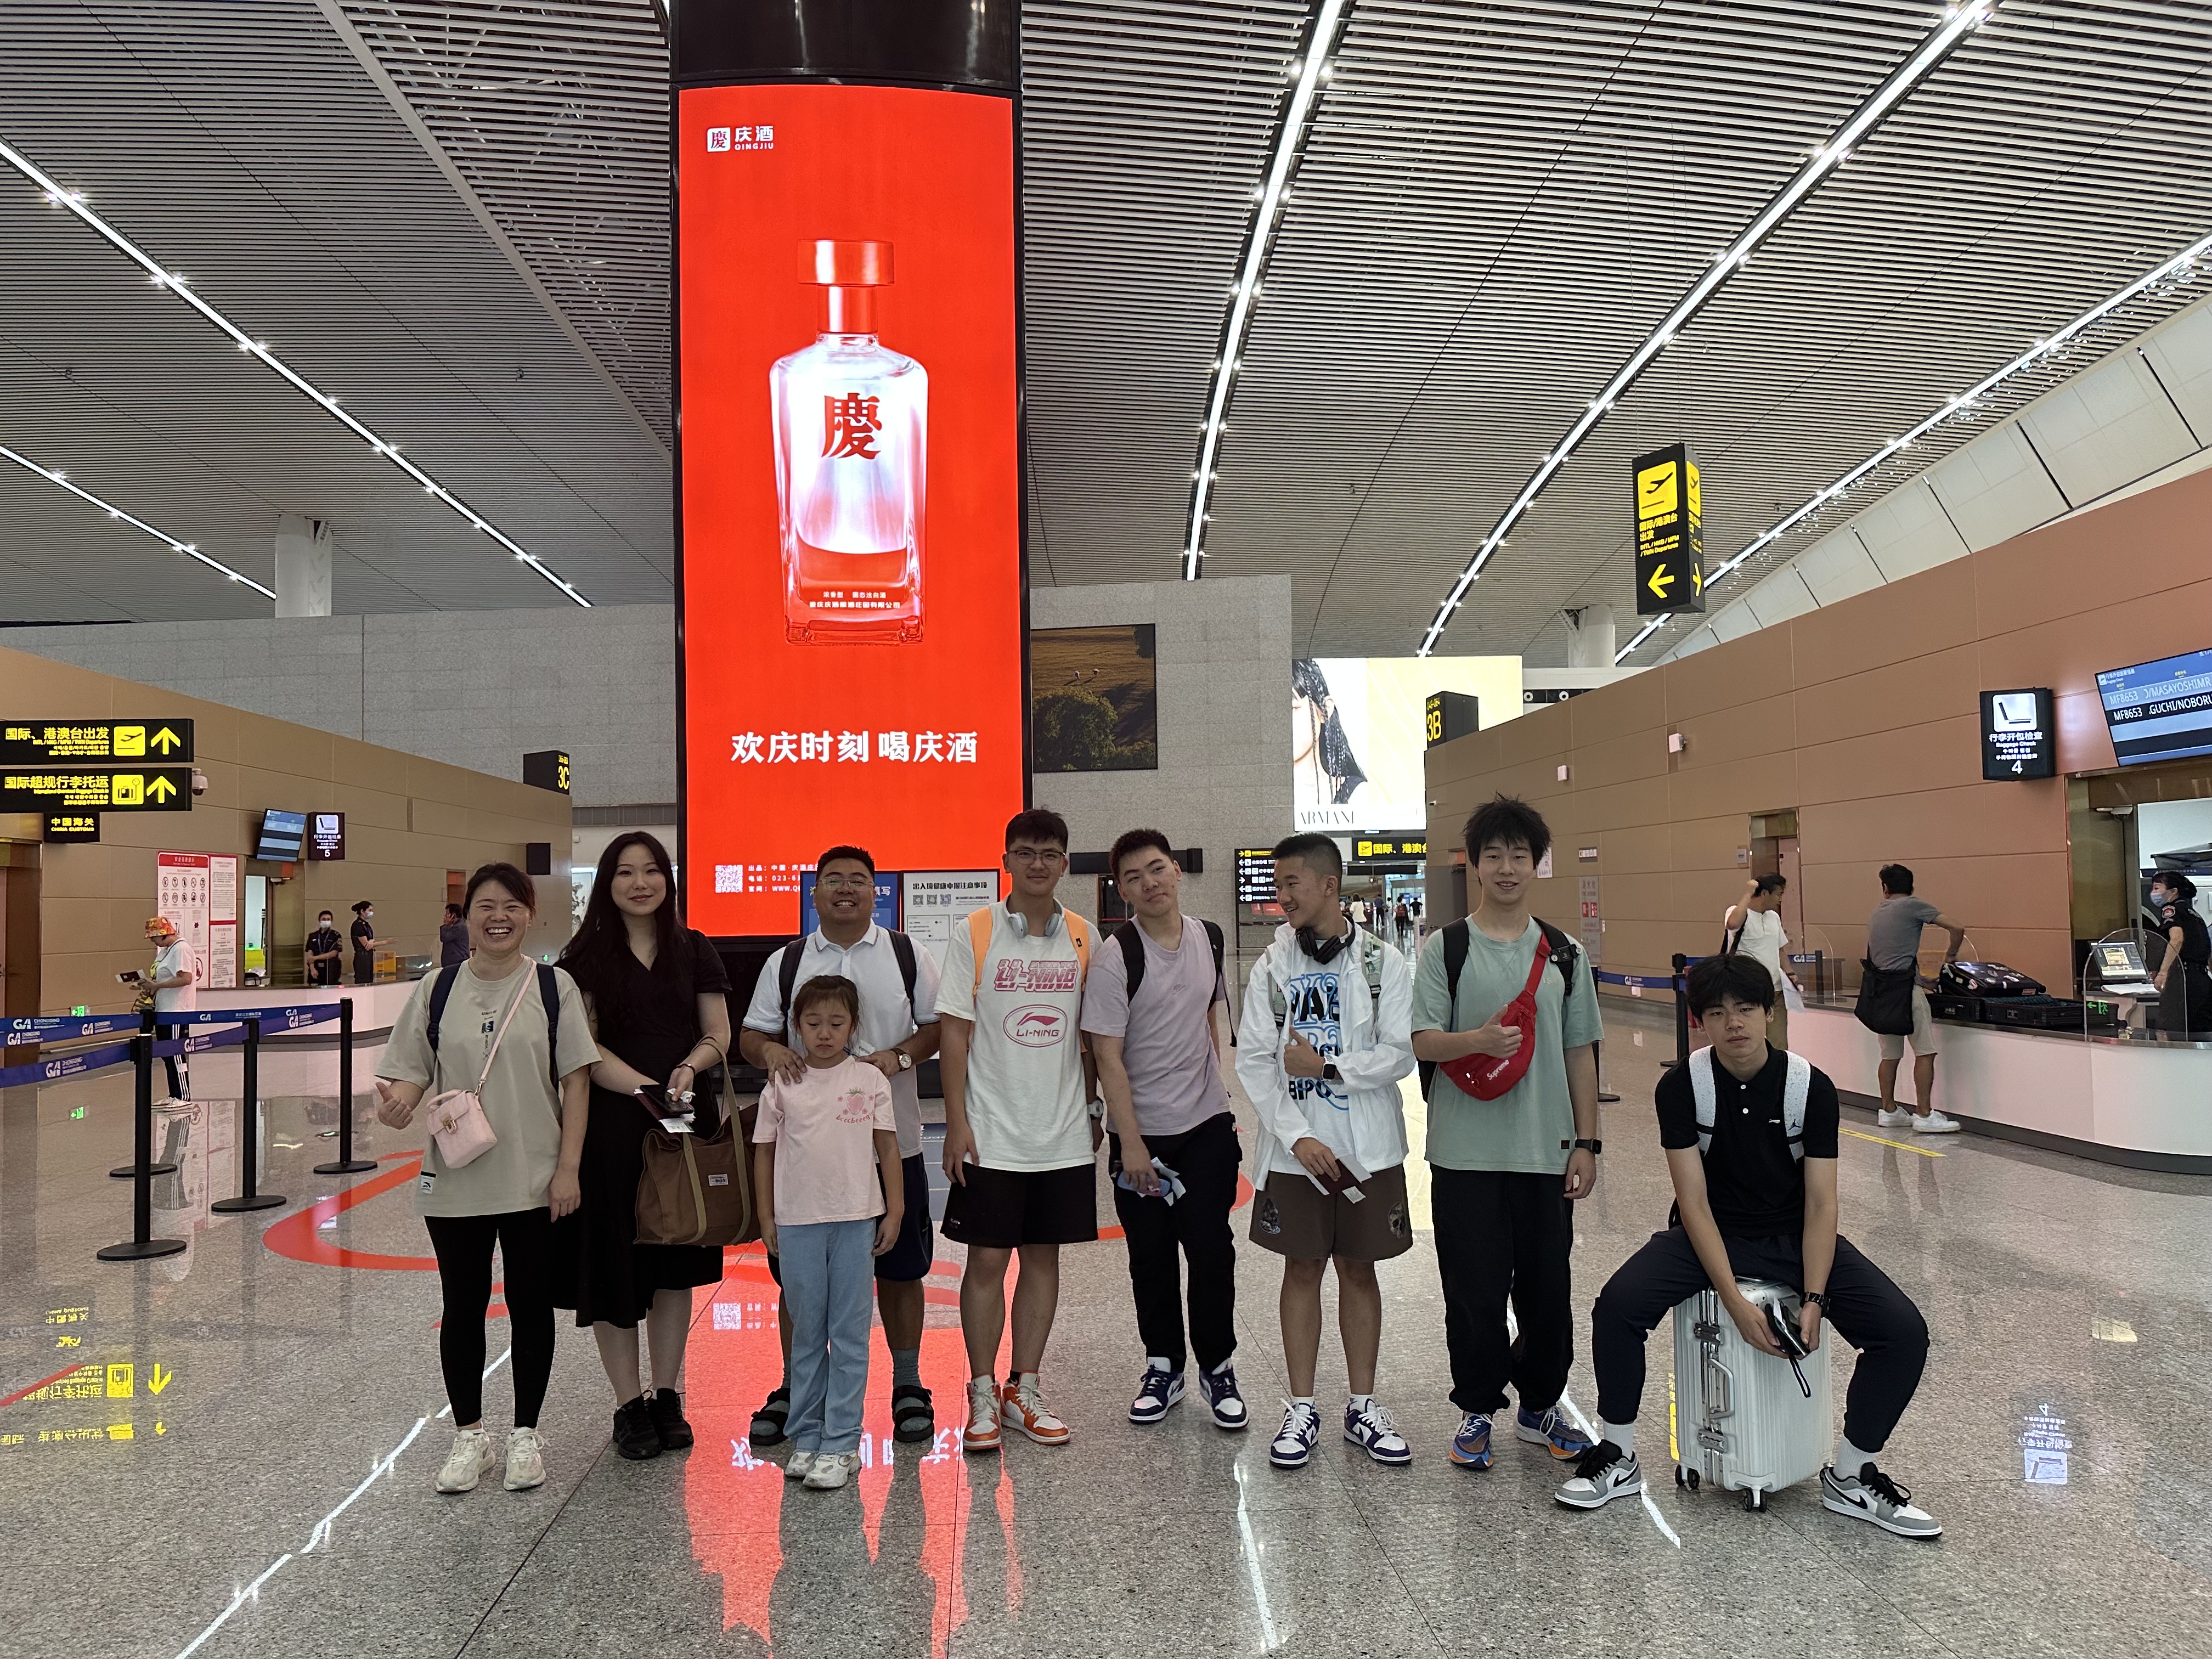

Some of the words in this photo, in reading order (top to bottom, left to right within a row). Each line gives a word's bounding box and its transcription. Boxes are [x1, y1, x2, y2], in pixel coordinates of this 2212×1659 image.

[735, 126, 774, 142] 庆酒
[821, 392, 883, 460] 慶
[1640, 529, 1655, 542] 出发
[2109, 691, 2138, 705] MF8653
[2113, 707, 2142, 721] MF8653
[2149, 695, 2212, 715] GUCHI/NOBORU
[5, 727, 109, 740] 国际、港澳台出发
[1427, 710, 1441, 742] 3B
[1989, 731, 2043, 742] 行李开包检查
[730, 730, 868, 764] 欢庆时刻
[878, 731, 978, 763] 喝庆酒
[2011, 760, 2023, 774] 4
[4, 776, 109, 789] 国际超规行李托运
[558, 765, 569, 790] 3C
[51, 817, 94, 826] 中国海关
[1300, 811, 1353, 824] ARMANI
[995, 960, 1077, 991] LI-NING
[1487, 1059, 1509, 1080] Supreme
